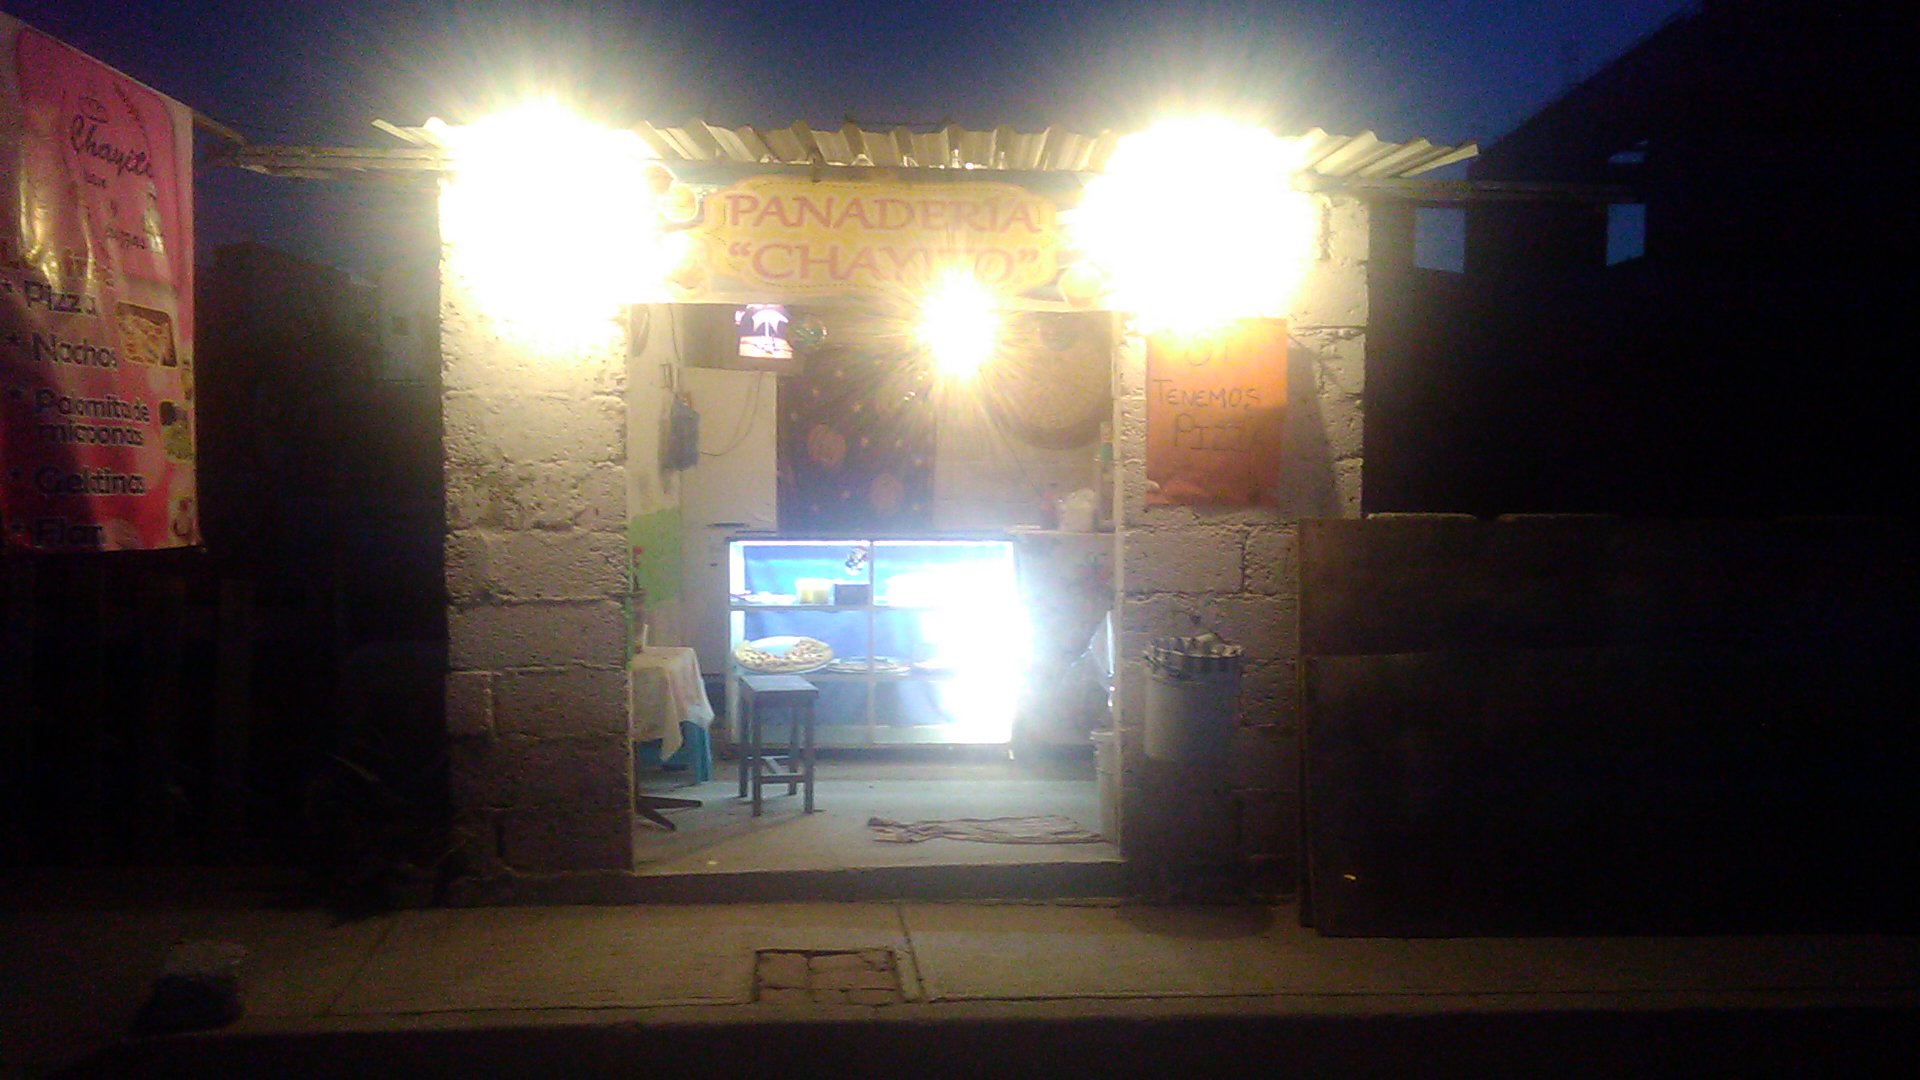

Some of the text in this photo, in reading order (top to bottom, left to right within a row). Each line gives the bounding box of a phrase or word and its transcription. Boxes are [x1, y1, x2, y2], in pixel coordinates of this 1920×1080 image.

[725, 194, 1043, 235] PANADERIA
[32, 331, 117, 367] Nachos
[1153, 378, 1261, 410] TENEMOS
